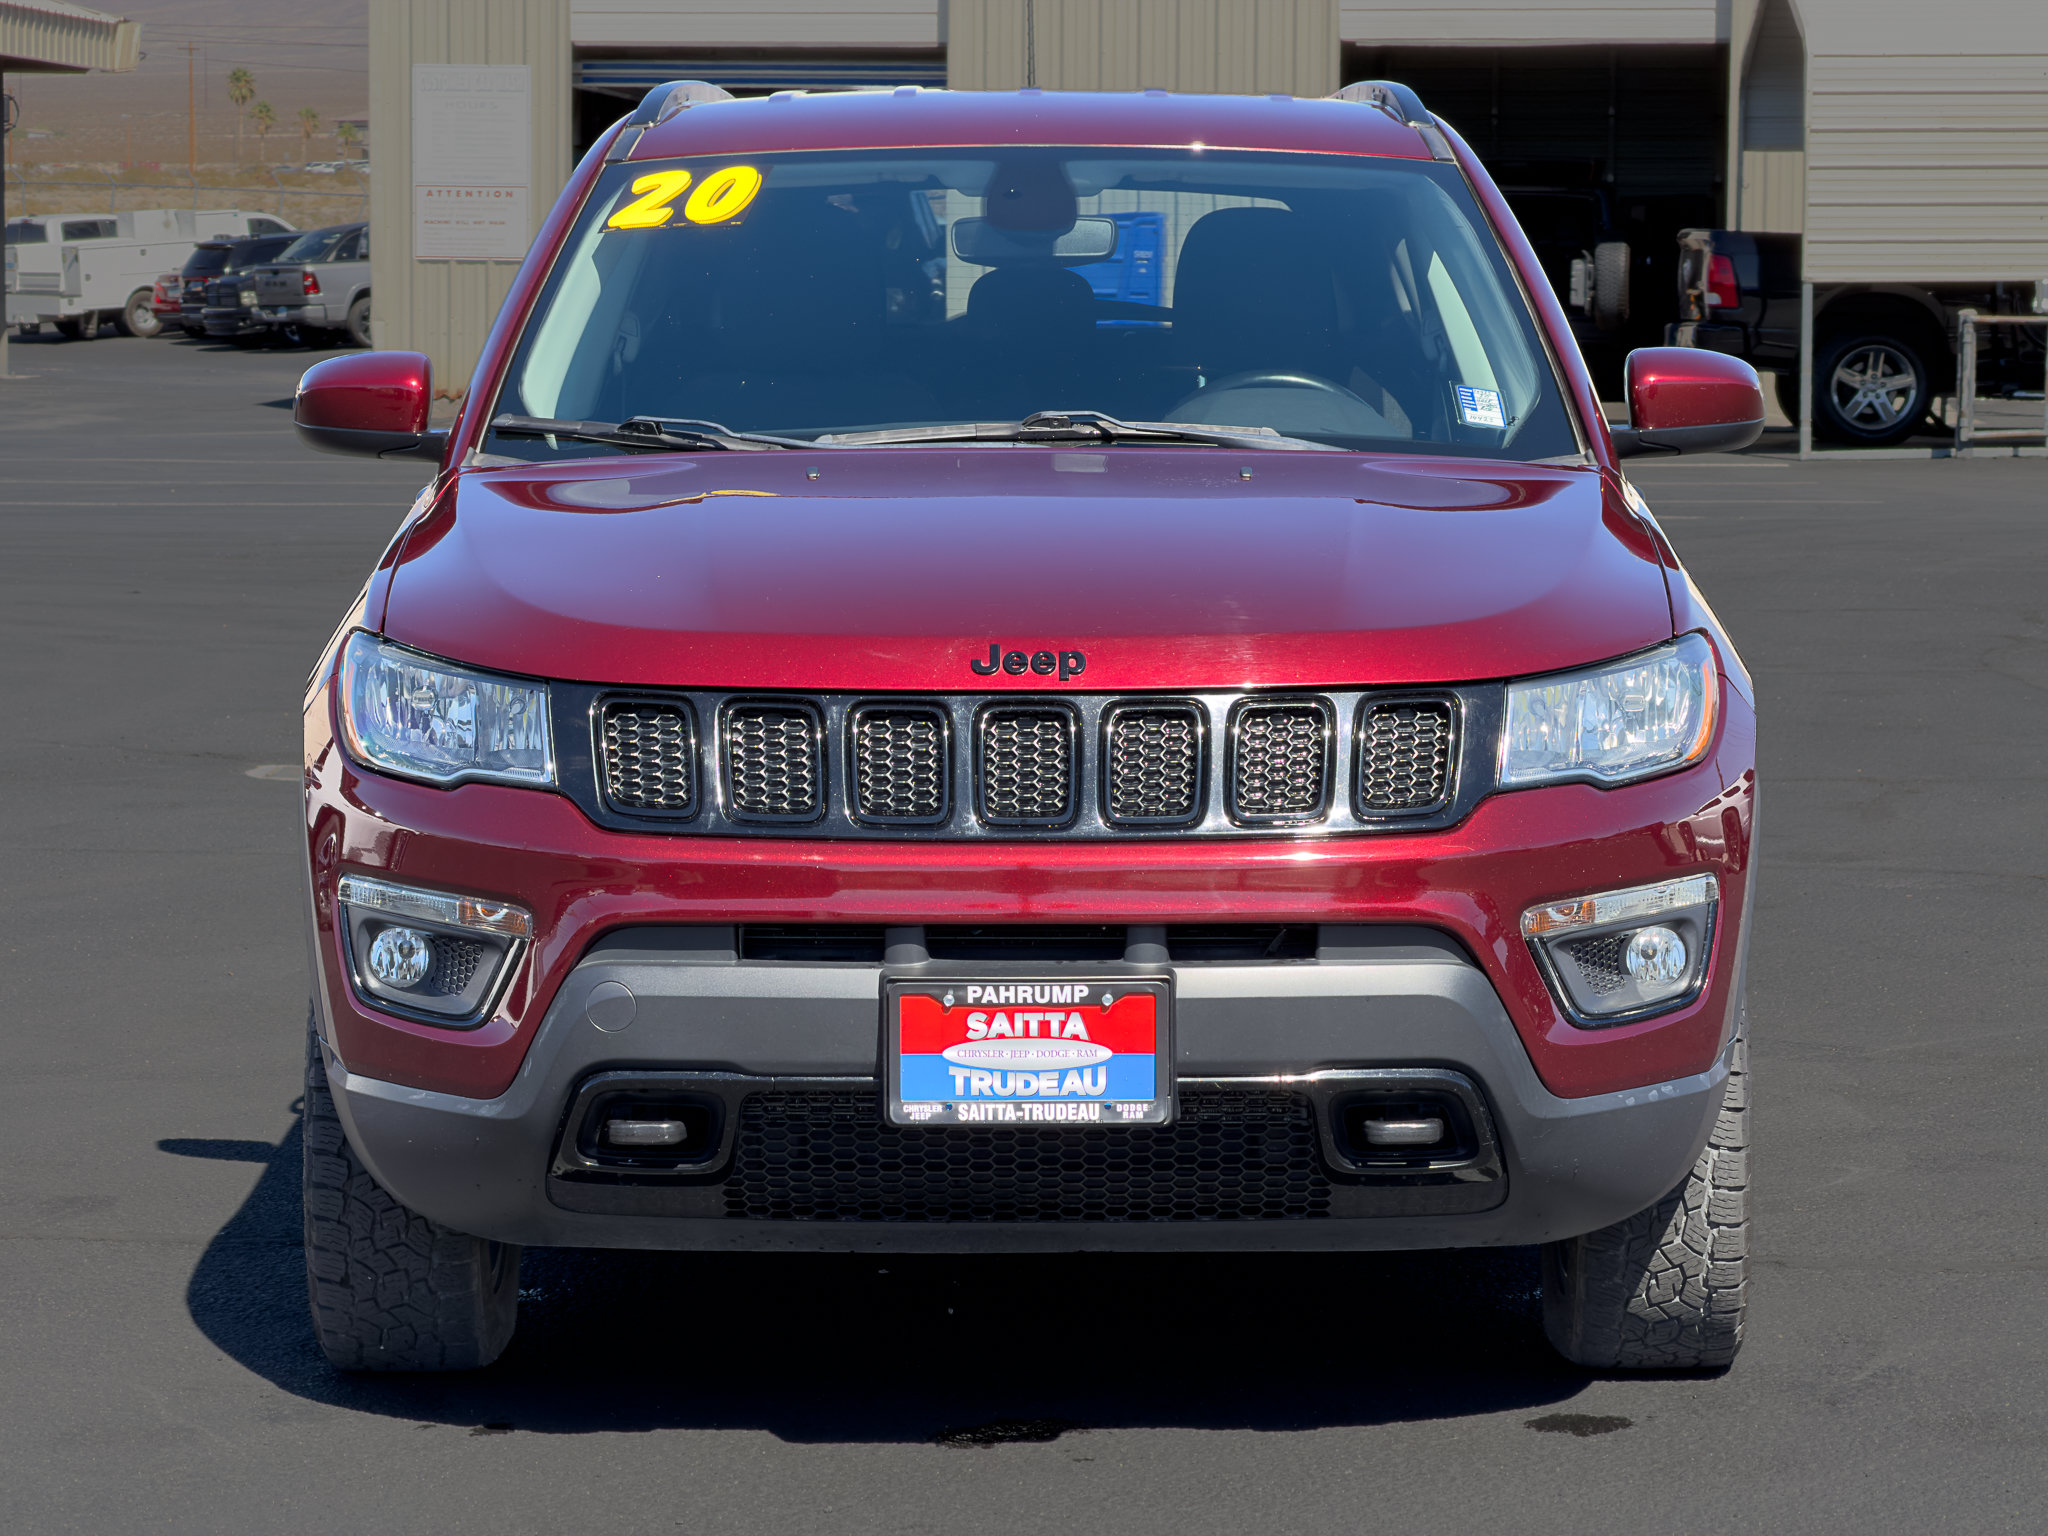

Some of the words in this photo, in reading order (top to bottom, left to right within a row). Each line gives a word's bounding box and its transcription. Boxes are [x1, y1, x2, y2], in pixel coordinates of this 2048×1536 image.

[426, 190, 514, 198] ATTENTION
[607, 166, 763, 230] 20
[971, 644, 1086, 681] Jeep
[967, 986, 1089, 1004] PAHRUMP
[966, 1012, 1090, 1040] SAITTA
[957, 1049, 1004, 1058] CHRYSLER
[1009, 1049, 1030, 1060] JEEP
[1036, 1049, 1071, 1058] DODGE
[1076, 1049, 1098, 1058] RAM
[949, 1066, 1107, 1097] TRUDEAU
[909, 1112, 932, 1120] JEEP
[958, 1103, 1100, 1121] SAITTA-TRUDEAU
[1116, 1103, 1148, 1112] DODGE
[1122, 1111, 1144, 1119] RAM
